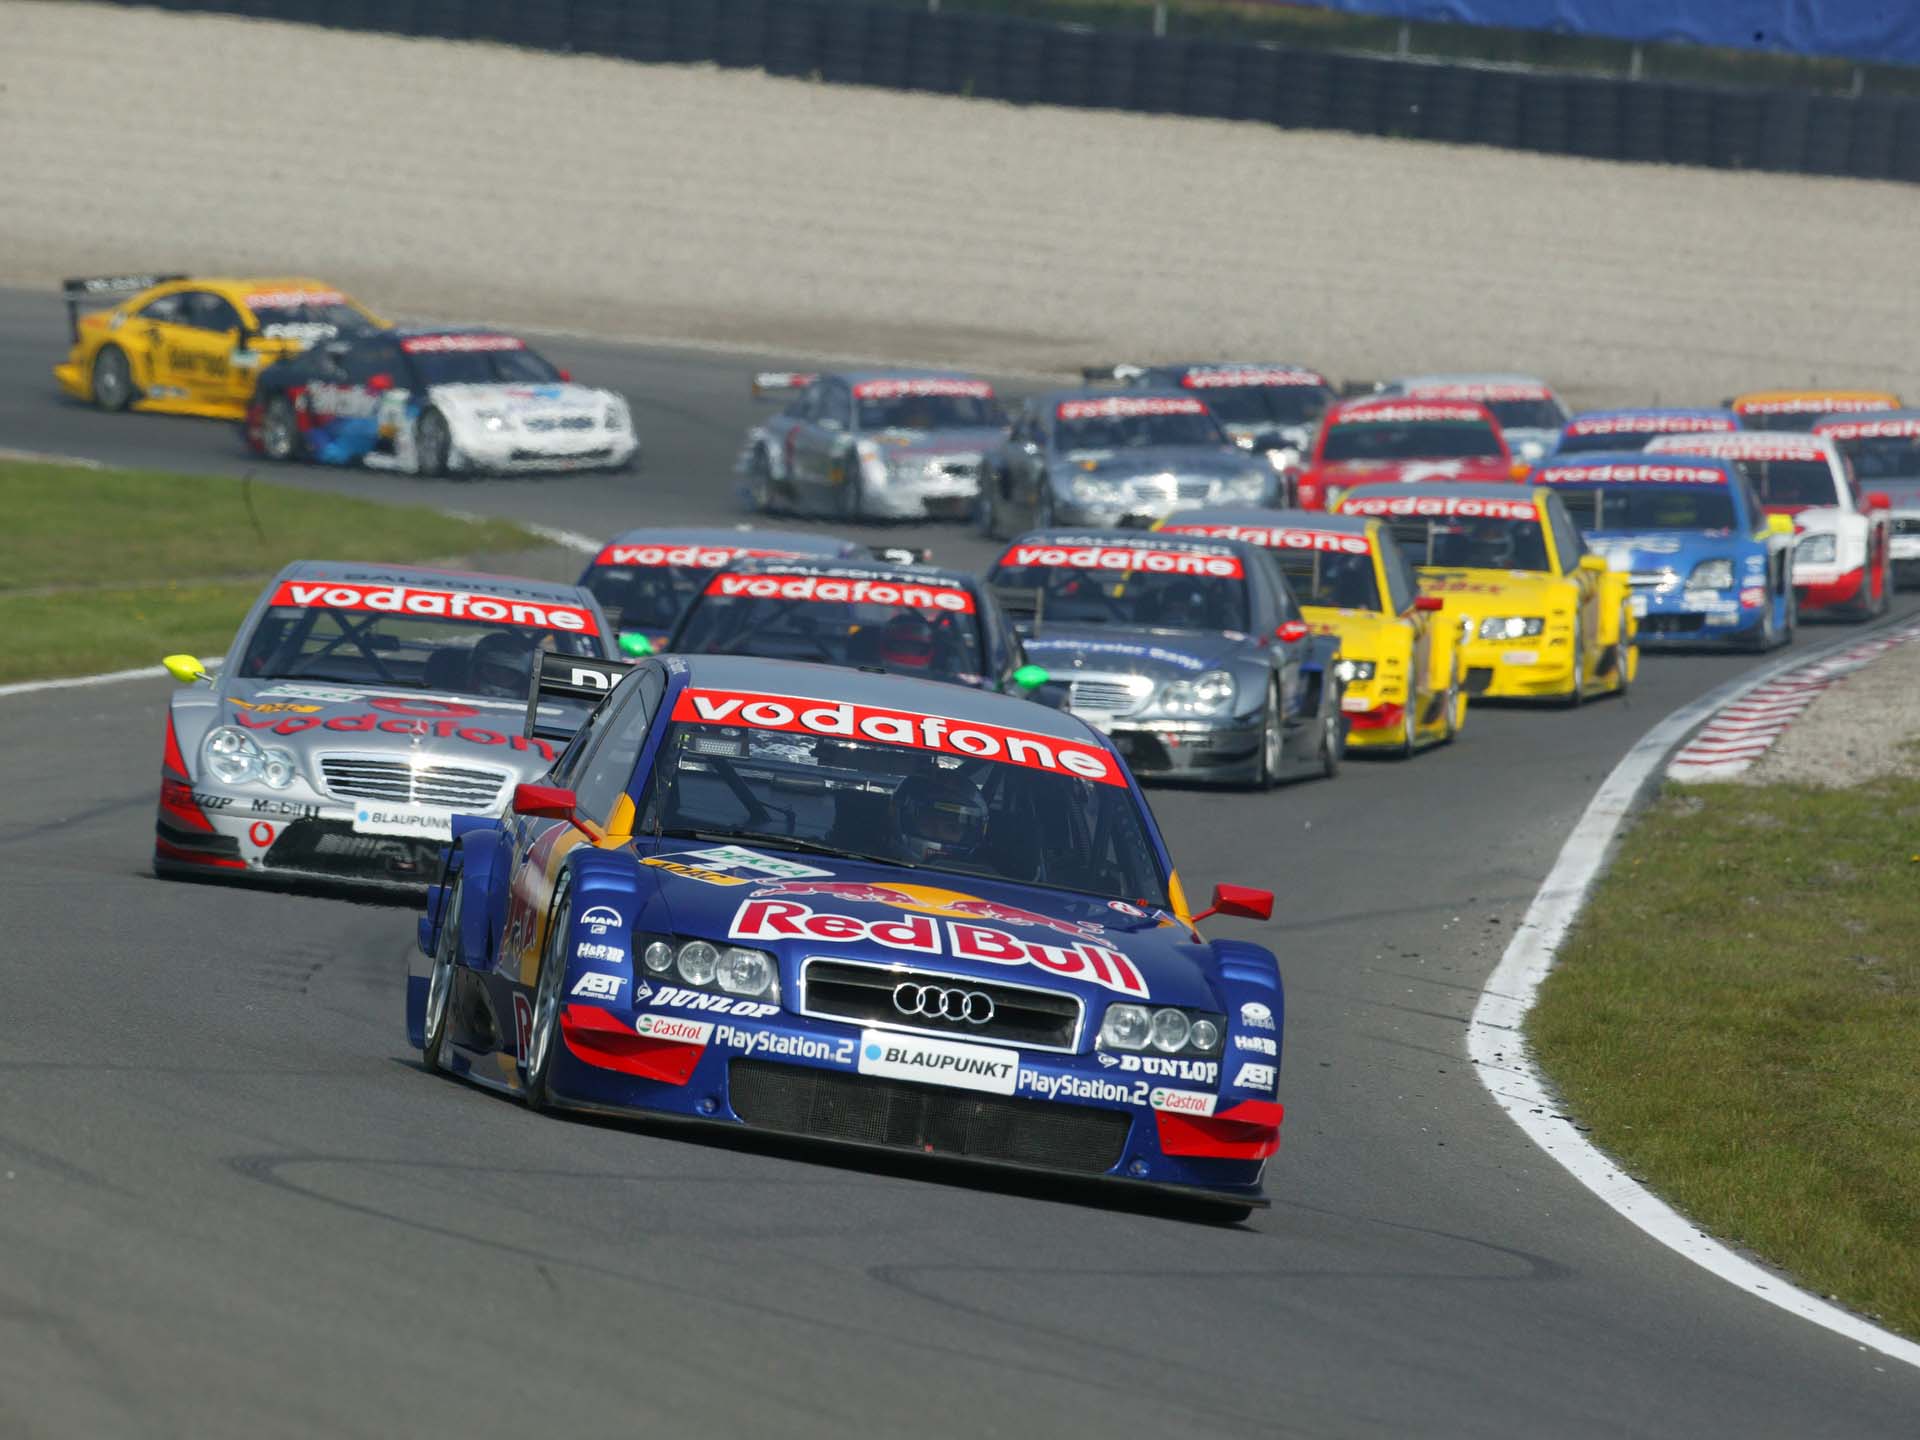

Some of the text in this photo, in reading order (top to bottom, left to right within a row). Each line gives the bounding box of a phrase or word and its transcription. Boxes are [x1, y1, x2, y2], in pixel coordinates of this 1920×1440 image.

[1824, 421, 1920, 438] vodaf
[1545, 465, 1720, 483] vodafone
[1343, 498, 1534, 519] vodafone
[1017, 547, 1235, 575] vodafone
[290, 585, 585, 630] vodafone
[721, 577, 966, 611] vodafone
[234, 711, 563, 762] vodafon
[694, 696, 1107, 779] vodafone
[654, 861, 728, 881] ADAC
[701, 850, 811, 877] DEKRA
[584, 916, 619, 928] MAN
[736, 900, 1144, 994] Red Bull
[570, 971, 628, 997] ABT
[650, 986, 780, 1018] DUNLOP
[653, 1019, 702, 1039] Castrol
[884, 1046, 1013, 1079] BLAUPUNKT
[1120, 1054, 1218, 1084] DUNLOP
[1233, 1062, 1277, 1087] ABT
[1165, 1093, 1209, 1112] Castrol
